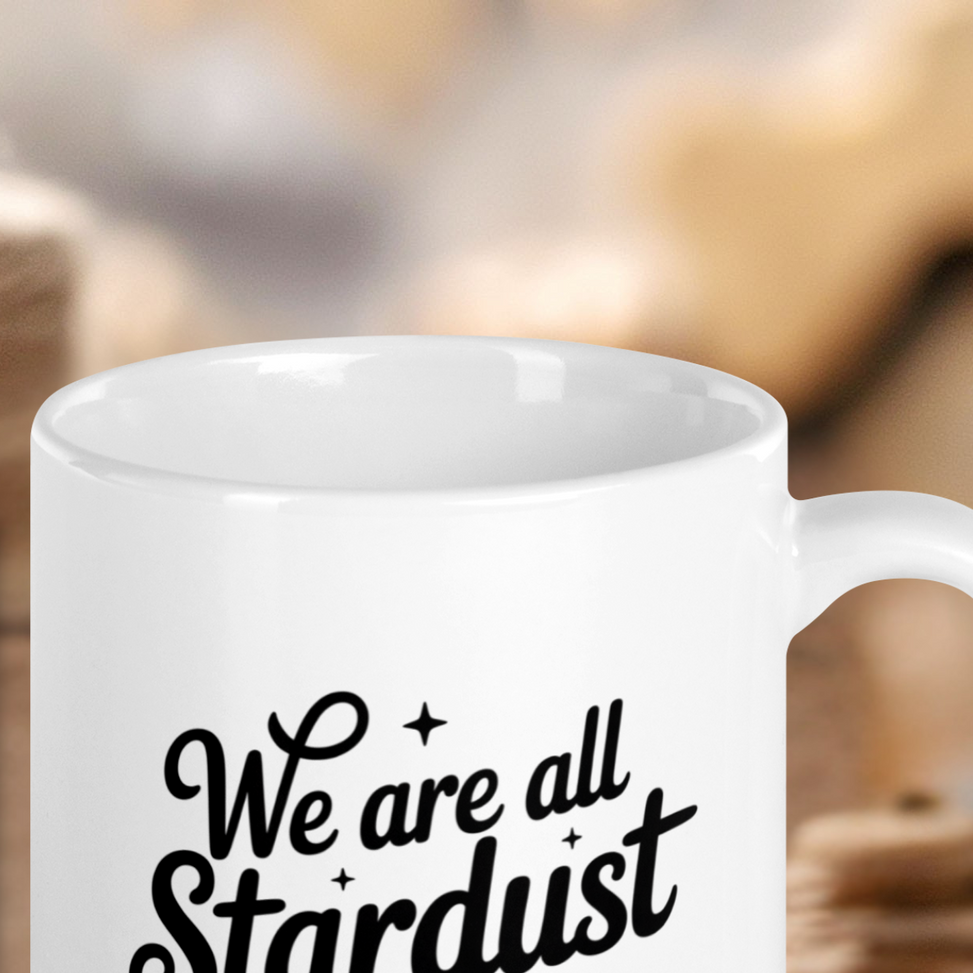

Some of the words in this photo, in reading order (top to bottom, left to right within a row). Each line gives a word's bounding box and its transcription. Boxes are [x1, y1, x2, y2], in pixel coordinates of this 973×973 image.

[163, 691, 370, 861] We
[359, 768, 505, 851] are
[525, 698, 631, 821] all
